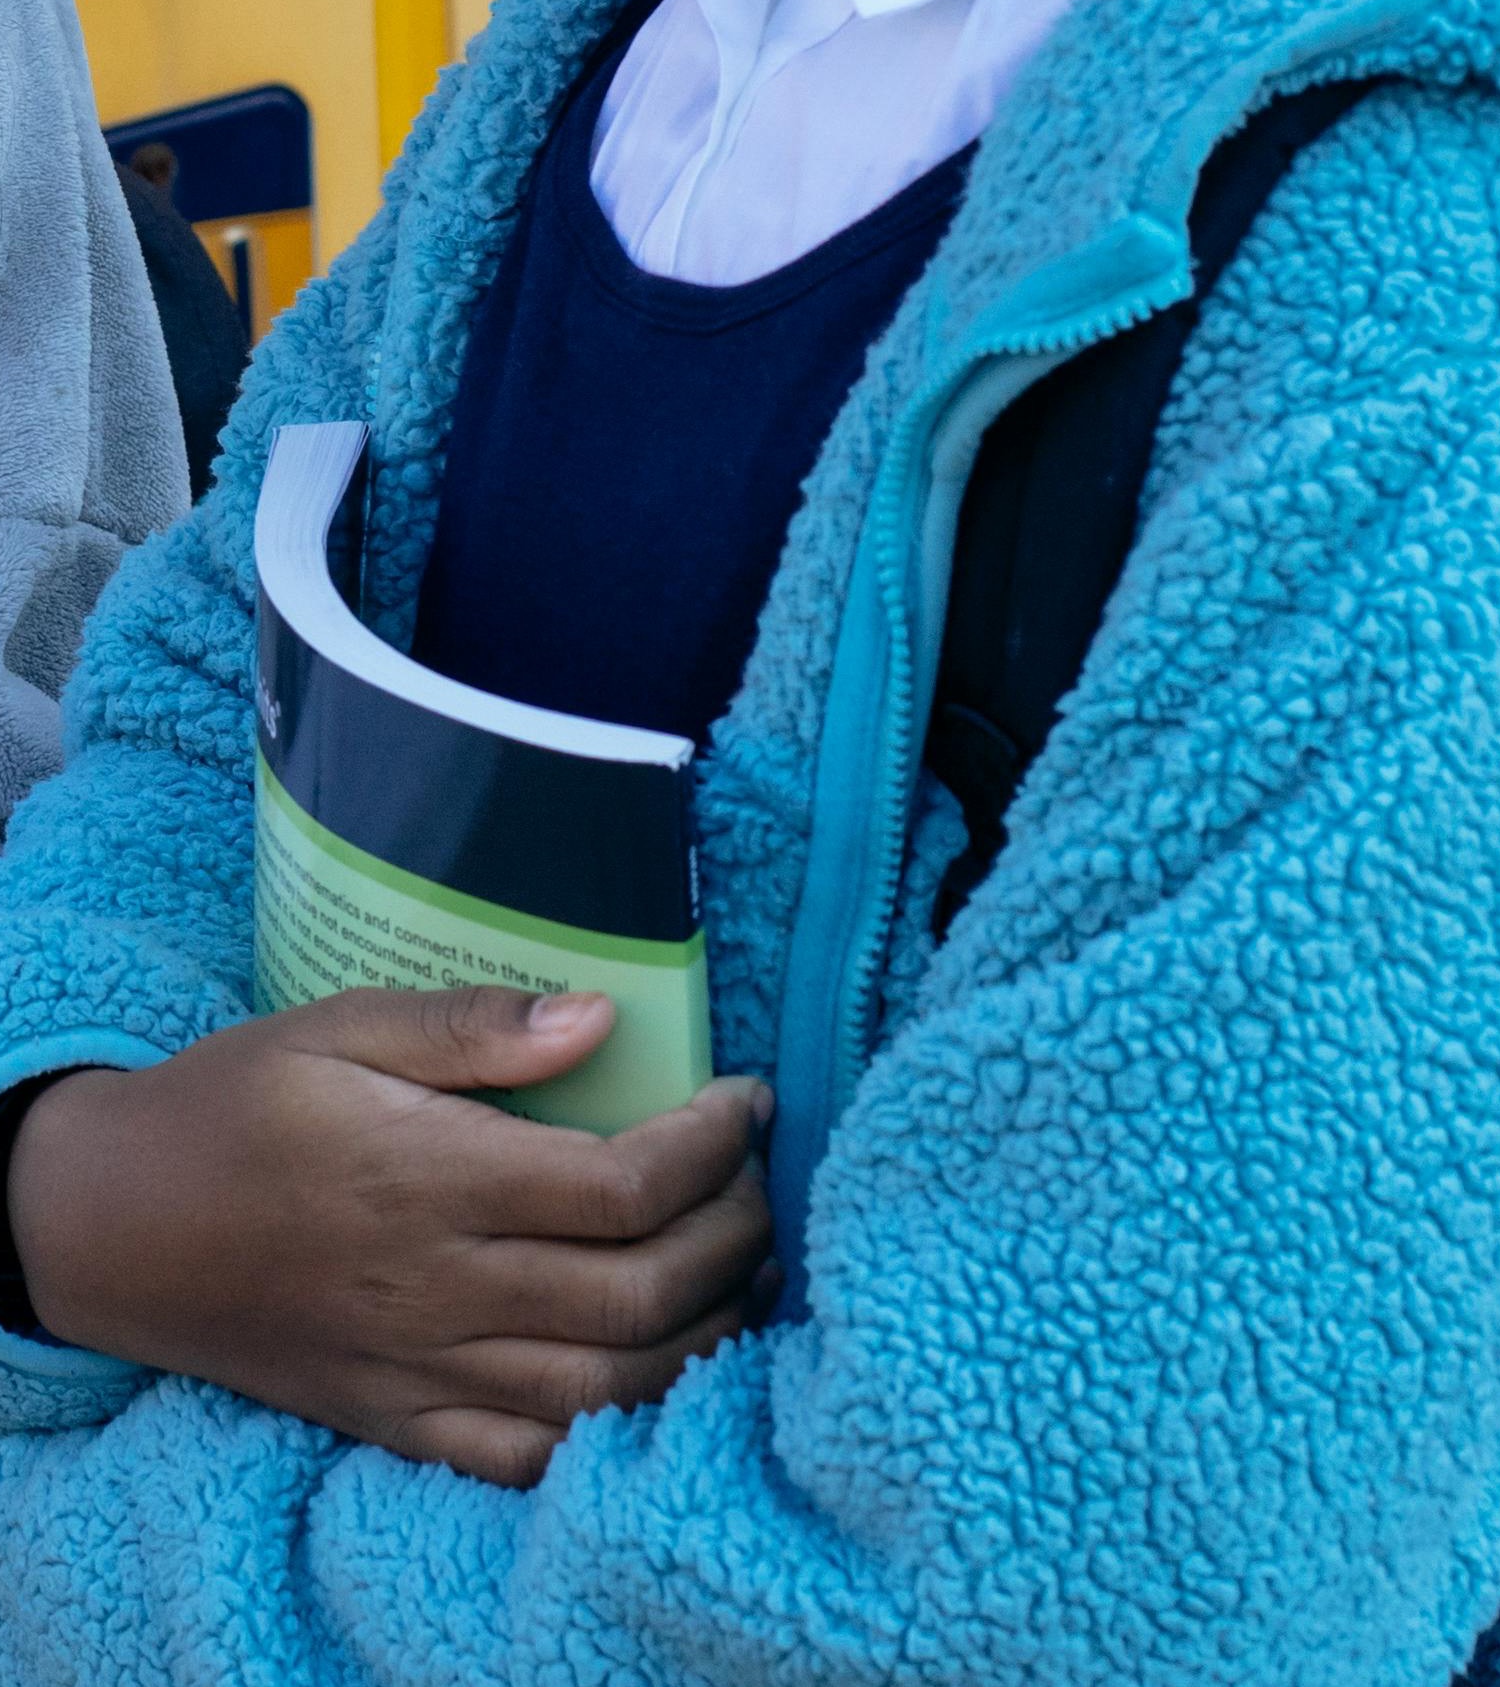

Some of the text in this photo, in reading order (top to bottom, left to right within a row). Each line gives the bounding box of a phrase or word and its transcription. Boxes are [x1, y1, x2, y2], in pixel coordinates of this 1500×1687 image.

[314, 934, 357, 972] enough
[360, 958, 380, 983] for
[319, 911, 339, 935] not
[341, 925, 437, 981] encountered.
[364, 911, 391, 935] and
[394, 925, 458, 962] connect
[463, 947, 474, 969] it
[478, 955, 496, 975] to
[501, 964, 530, 986] the
[534, 976, 569, 994] real
